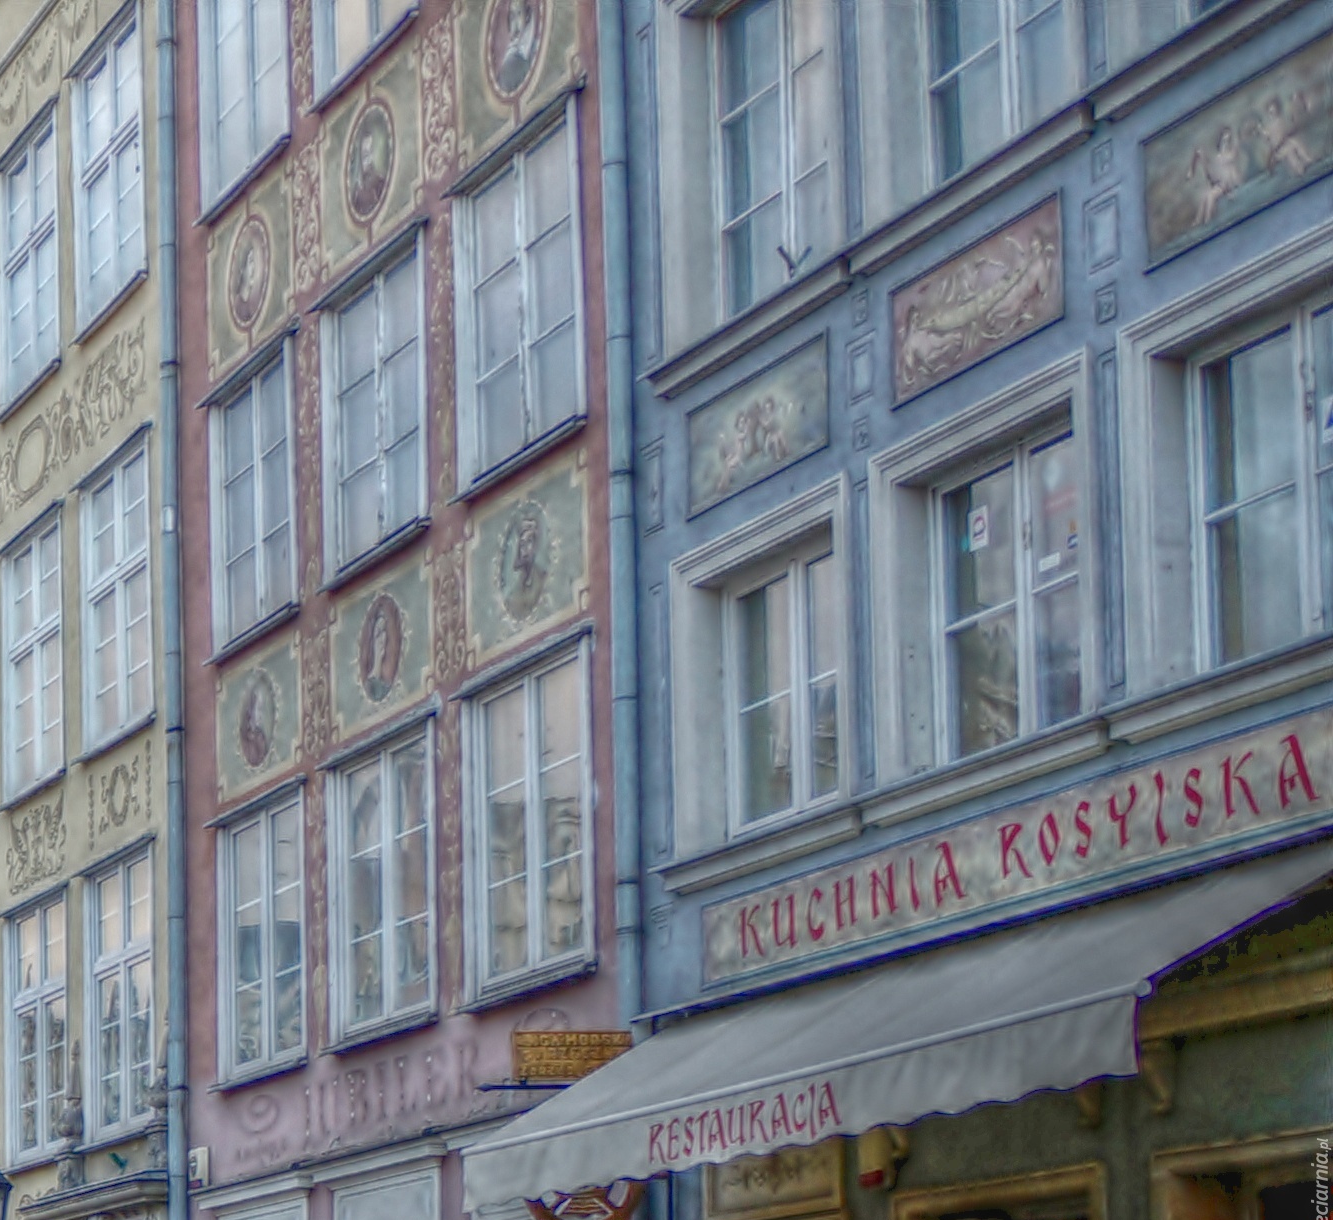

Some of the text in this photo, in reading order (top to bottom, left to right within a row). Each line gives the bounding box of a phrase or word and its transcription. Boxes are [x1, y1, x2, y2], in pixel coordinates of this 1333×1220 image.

[736, 734, 1320, 958] KUCHNIA ROSYJSKA
[649, 1080, 843, 1165] RESTAURACJA
